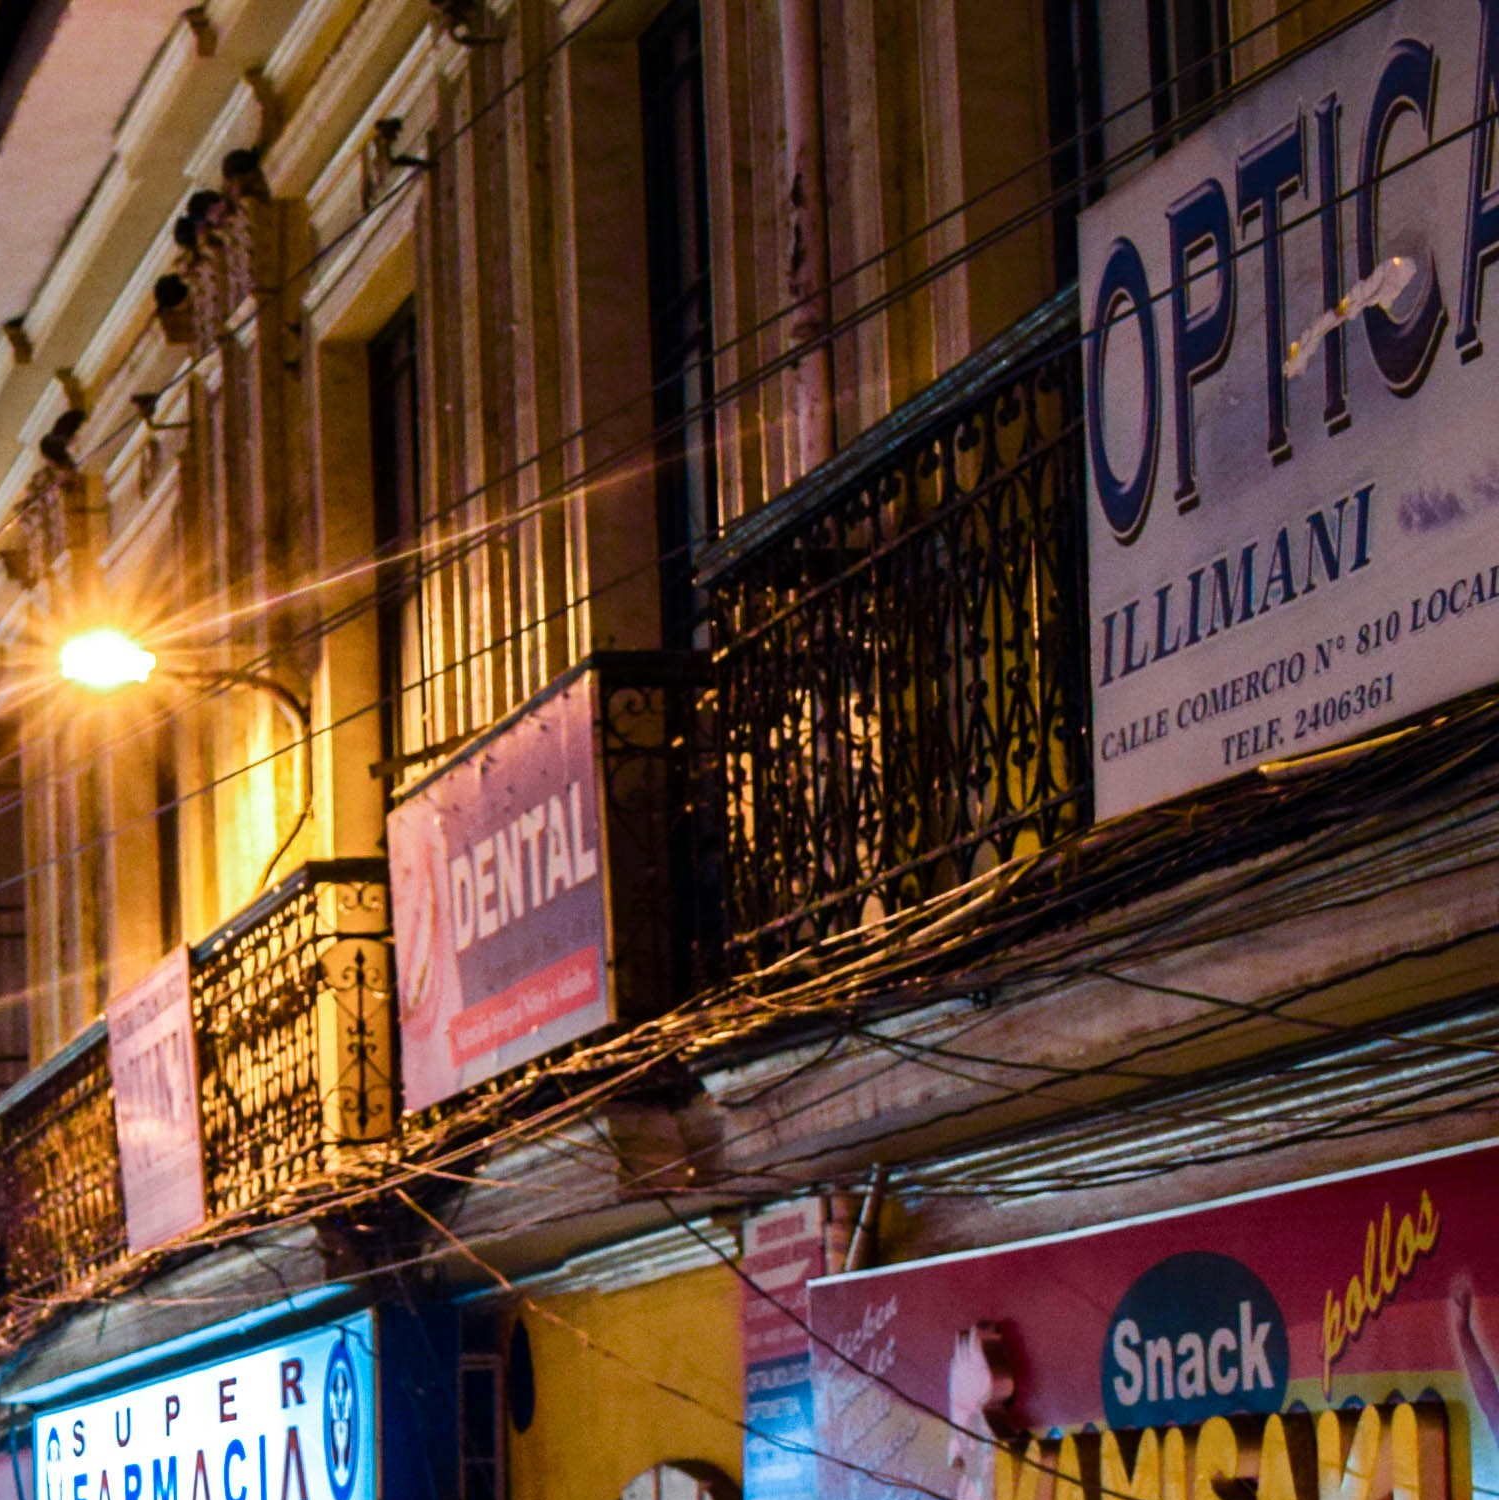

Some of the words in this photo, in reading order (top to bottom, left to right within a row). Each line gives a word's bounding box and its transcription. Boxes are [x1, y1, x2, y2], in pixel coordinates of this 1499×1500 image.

[1098, 485, 1376, 688] ILLIMANI
[1101, 707, 1170, 762] CALLE
[1176, 650, 1305, 730] COMERCIO
[1355, 610, 1401, 656] 810
[1221, 716, 1285, 766] TELF.
[1293, 671, 1395, 741] 2406361
[449, 782, 599, 953] DENTAL
[1111, 1300, 1276, 1407] Snack
[1321, 1189, 1441, 1396] pollos
[71, 1357, 307, 1458] SUPER
